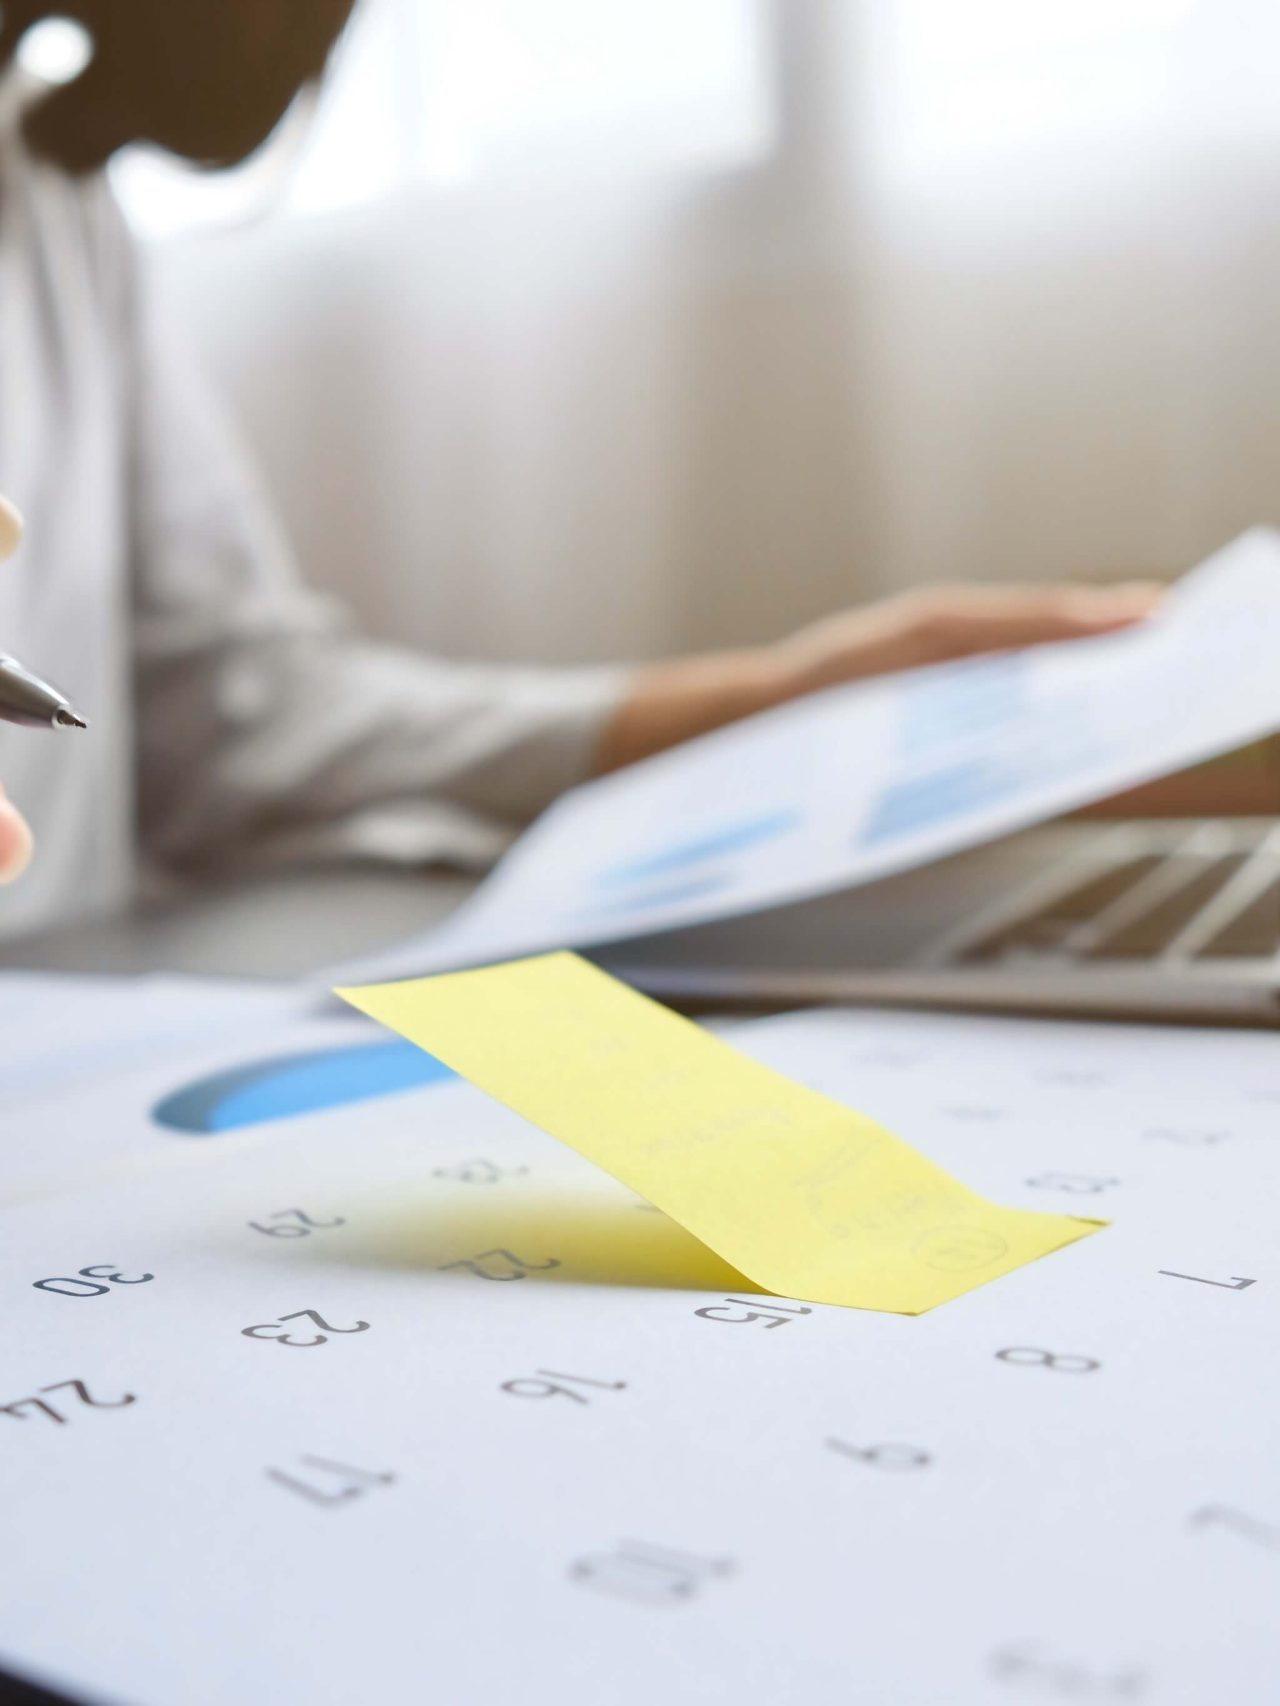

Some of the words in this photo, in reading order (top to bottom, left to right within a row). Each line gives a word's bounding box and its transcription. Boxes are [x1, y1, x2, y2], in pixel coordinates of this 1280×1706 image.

[247, 1208, 346, 1239] 29
[32, 1264, 155, 1298] 30
[437, 1248, 562, 1283] 22
[1157, 1269, 1258, 1291] 7
[240, 1309, 371, 1348] 23
[693, 1298, 813, 1330] 15
[993, 1347, 1102, 1374] 8
[498, 1369, 629, 1406] 16
